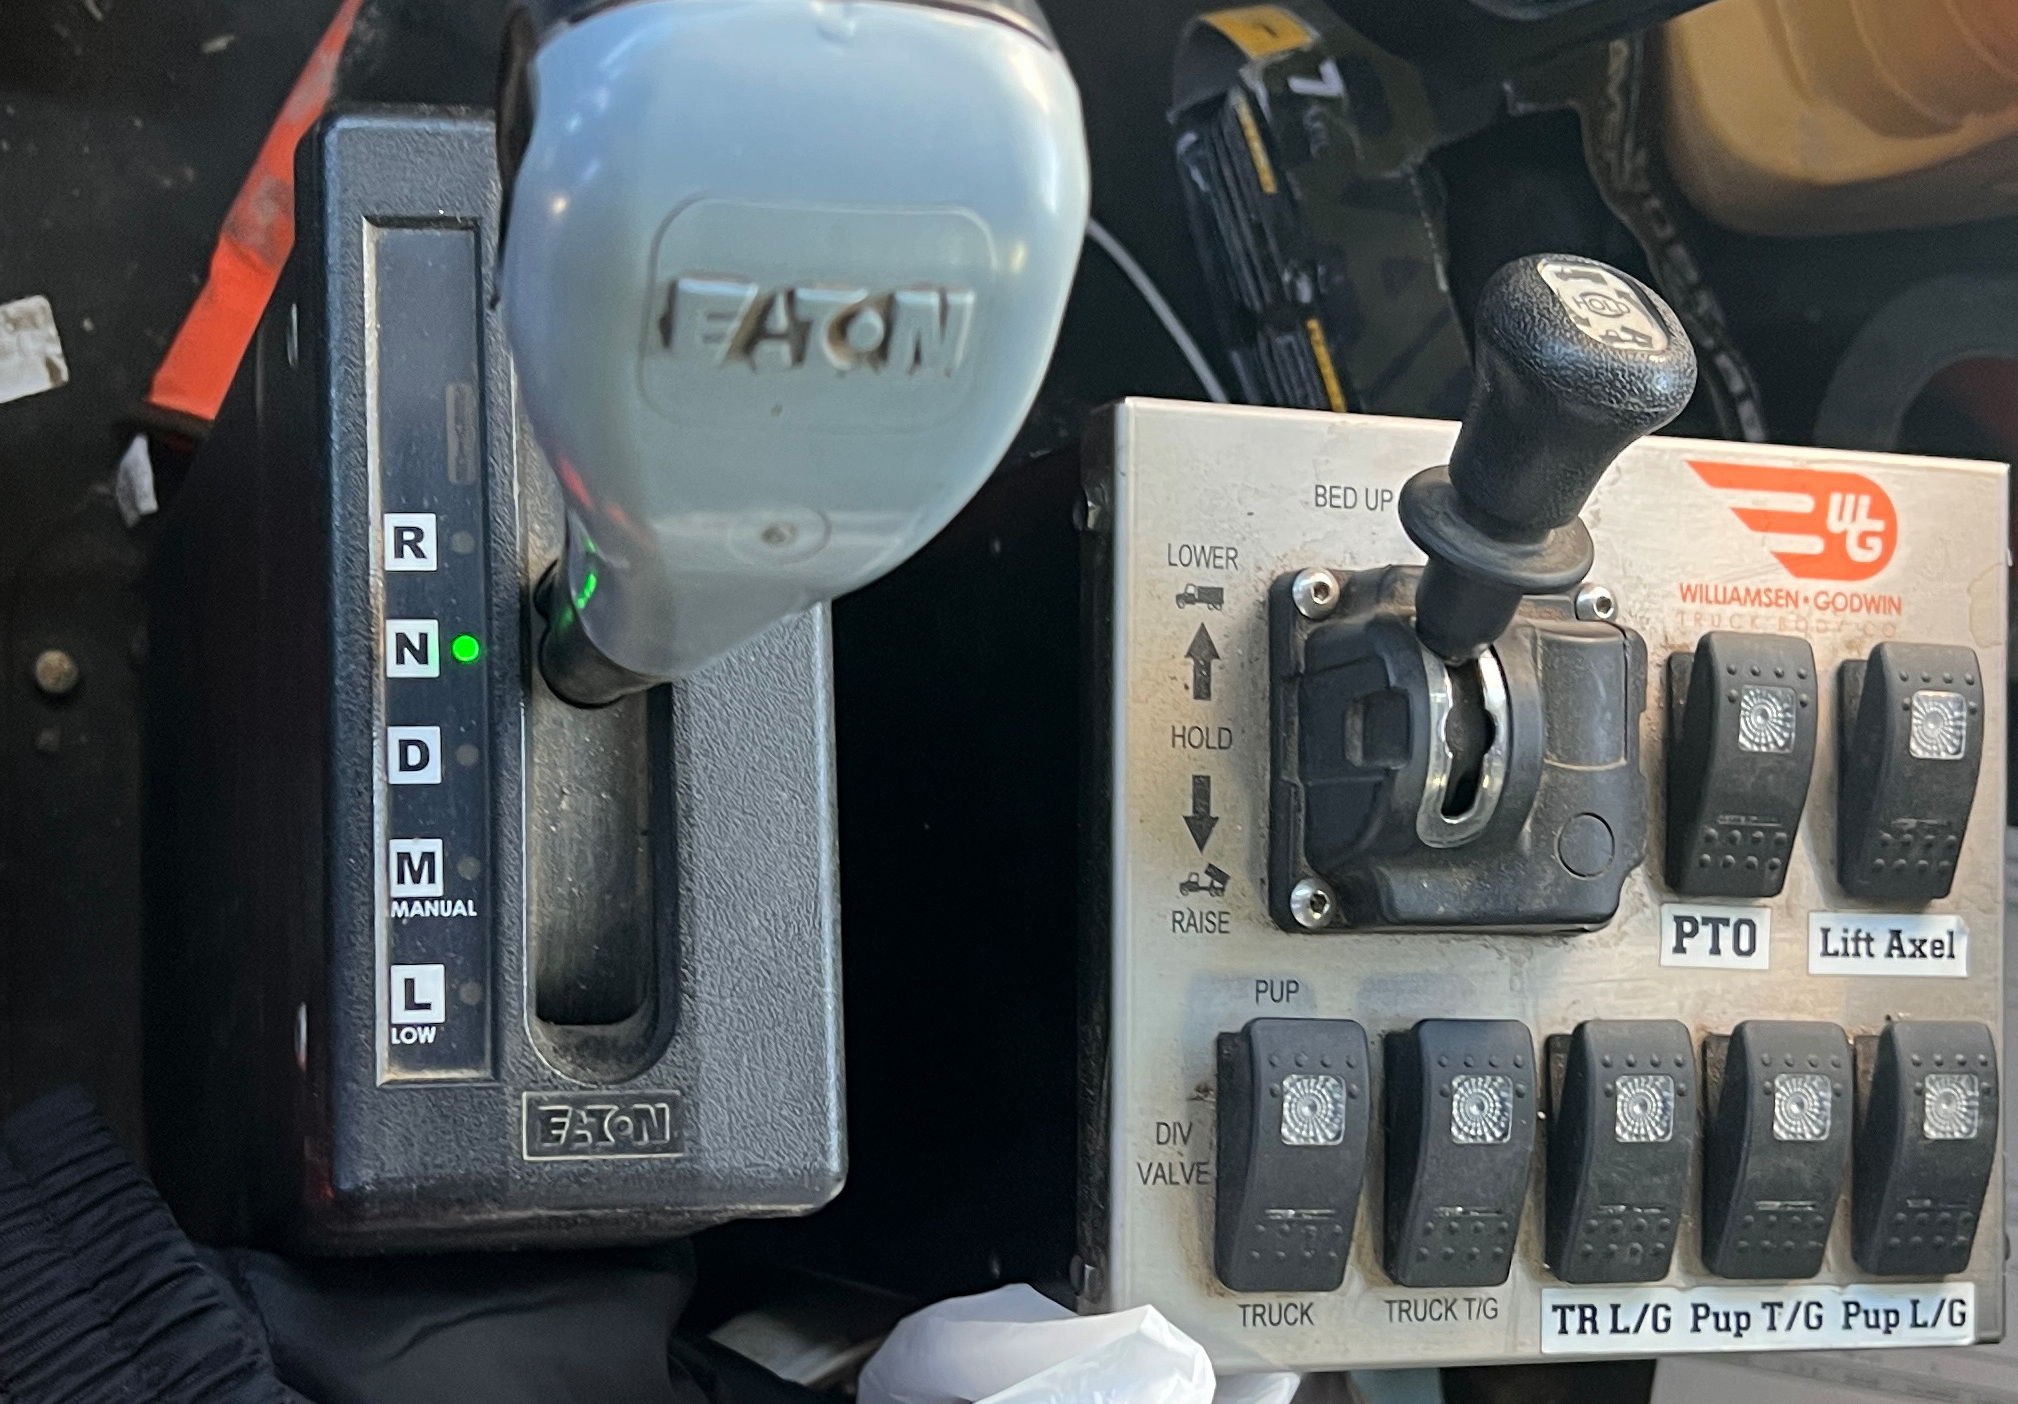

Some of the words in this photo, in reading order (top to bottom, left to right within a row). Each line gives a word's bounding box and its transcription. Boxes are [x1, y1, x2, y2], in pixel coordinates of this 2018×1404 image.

[659, 272, 974, 375] EATON
[1315, 485, 1355, 509] BED
[1364, 487, 1393, 511] UP
[393, 525, 428, 560] R
[1167, 543, 1239, 570] LOWER
[395, 631, 429, 666] N
[1171, 725, 1233, 750] HOLD
[398, 738, 431, 773] D
[396, 851, 436, 885] M
[390, 899, 478, 918] MANUAL
[1172, 911, 1231, 935] RAISE
[1672, 915, 1757, 956] PTO
[1820, 926, 1875, 960] Lift
[1884, 929, 1956, 960] Axel
[404, 978, 432, 1011] L
[1255, 979, 1300, 1004] PUP
[391, 1026, 436, 1045] LOW
[536, 1103, 671, 1148] EATON
[1156, 1121, 1193, 1146] DIV
[1137, 1161, 1211, 1186] VALVE
[1239, 1301, 1315, 1327] TRUCK
[1386, 1298, 1458, 1323] TRUCK
[1463, 1297, 1499, 1321] T/G
[1552, 1304, 1599, 1336] TR
[1609, 1303, 1672, 1335] L/G
[1690, 1303, 1752, 1338] Pup
[1761, 1301, 1824, 1331] T/G
[1841, 1300, 1901, 1334] Pup
[1909, 1298, 1968, 1328] L/G
